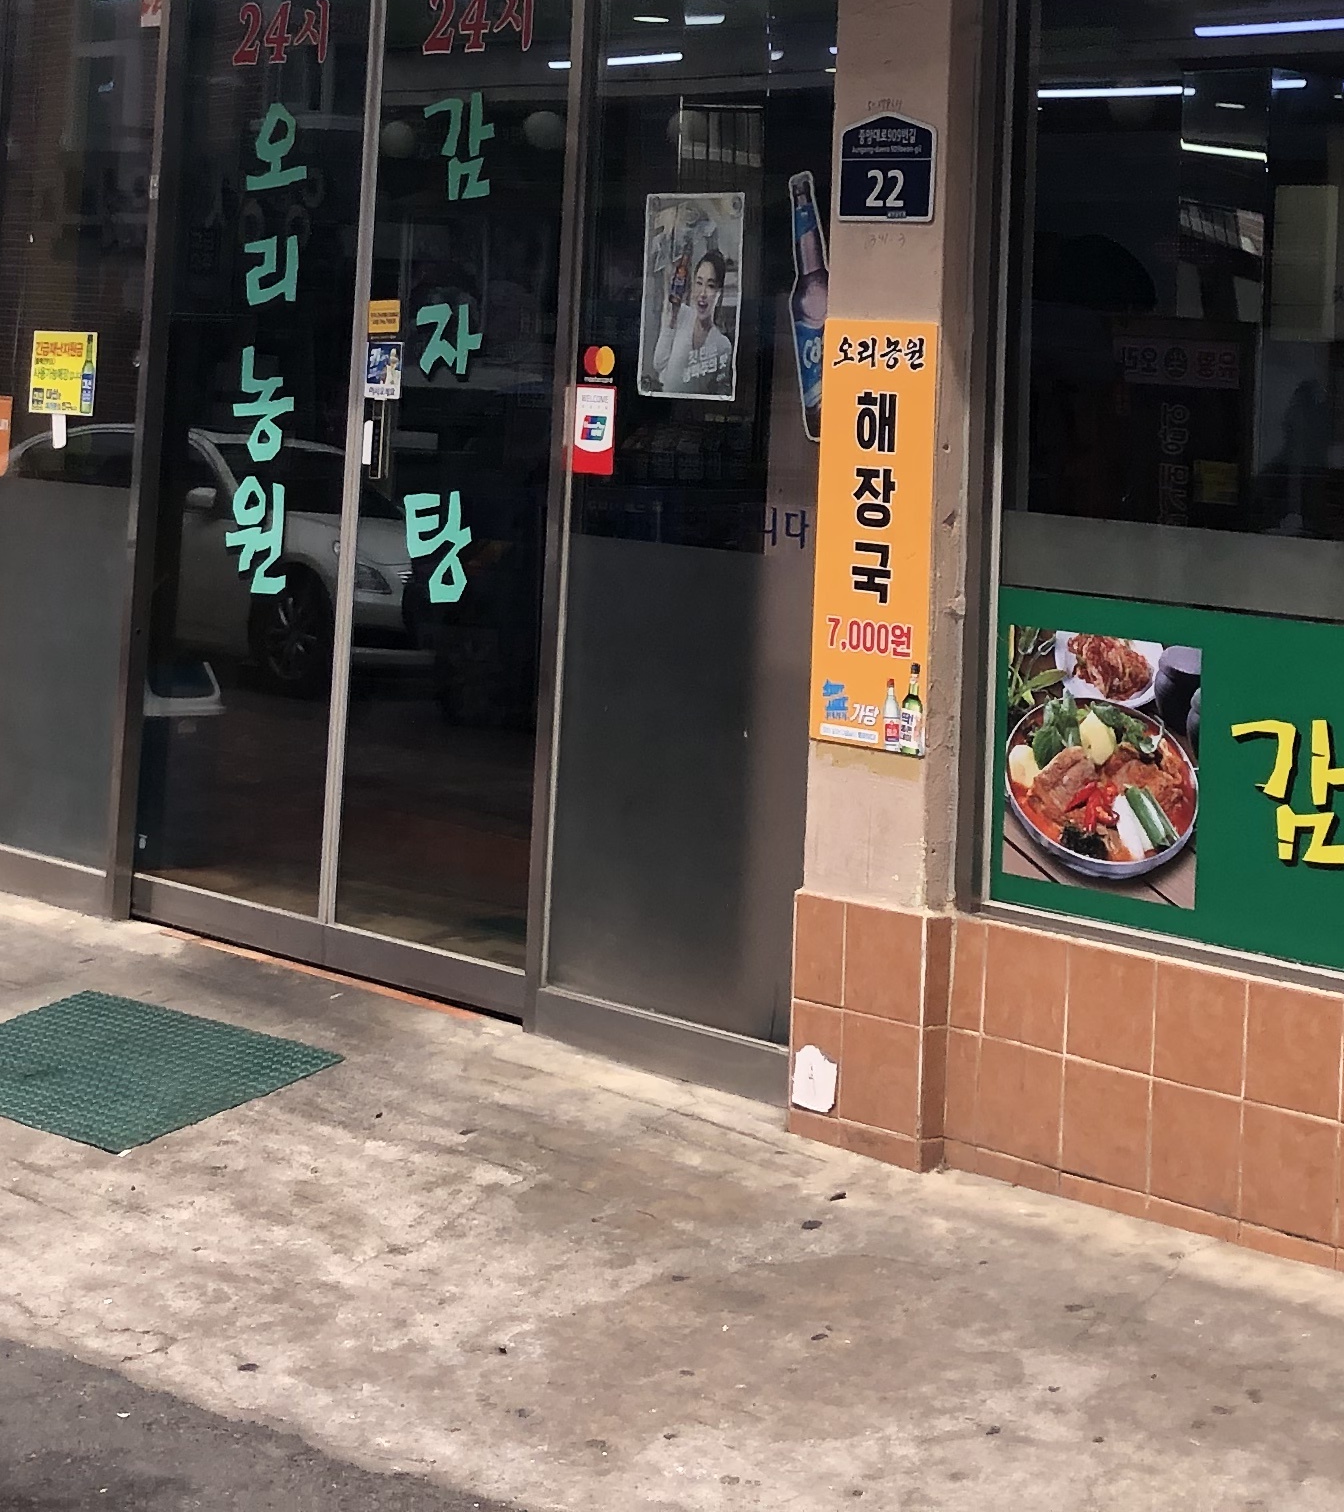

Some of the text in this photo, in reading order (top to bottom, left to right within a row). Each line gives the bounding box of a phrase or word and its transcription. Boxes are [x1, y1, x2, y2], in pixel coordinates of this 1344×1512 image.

[858, 128, 917, 145] 중앙대로909번길
[866, 169, 905, 208] 22
[226, 102, 307, 595] 오리농원
[404, 91, 495, 603] 감자탕
[833, 336, 926, 370] 오리농원
[852, 391, 898, 605] 해장국
[827, 616, 913, 658] 7,000원
